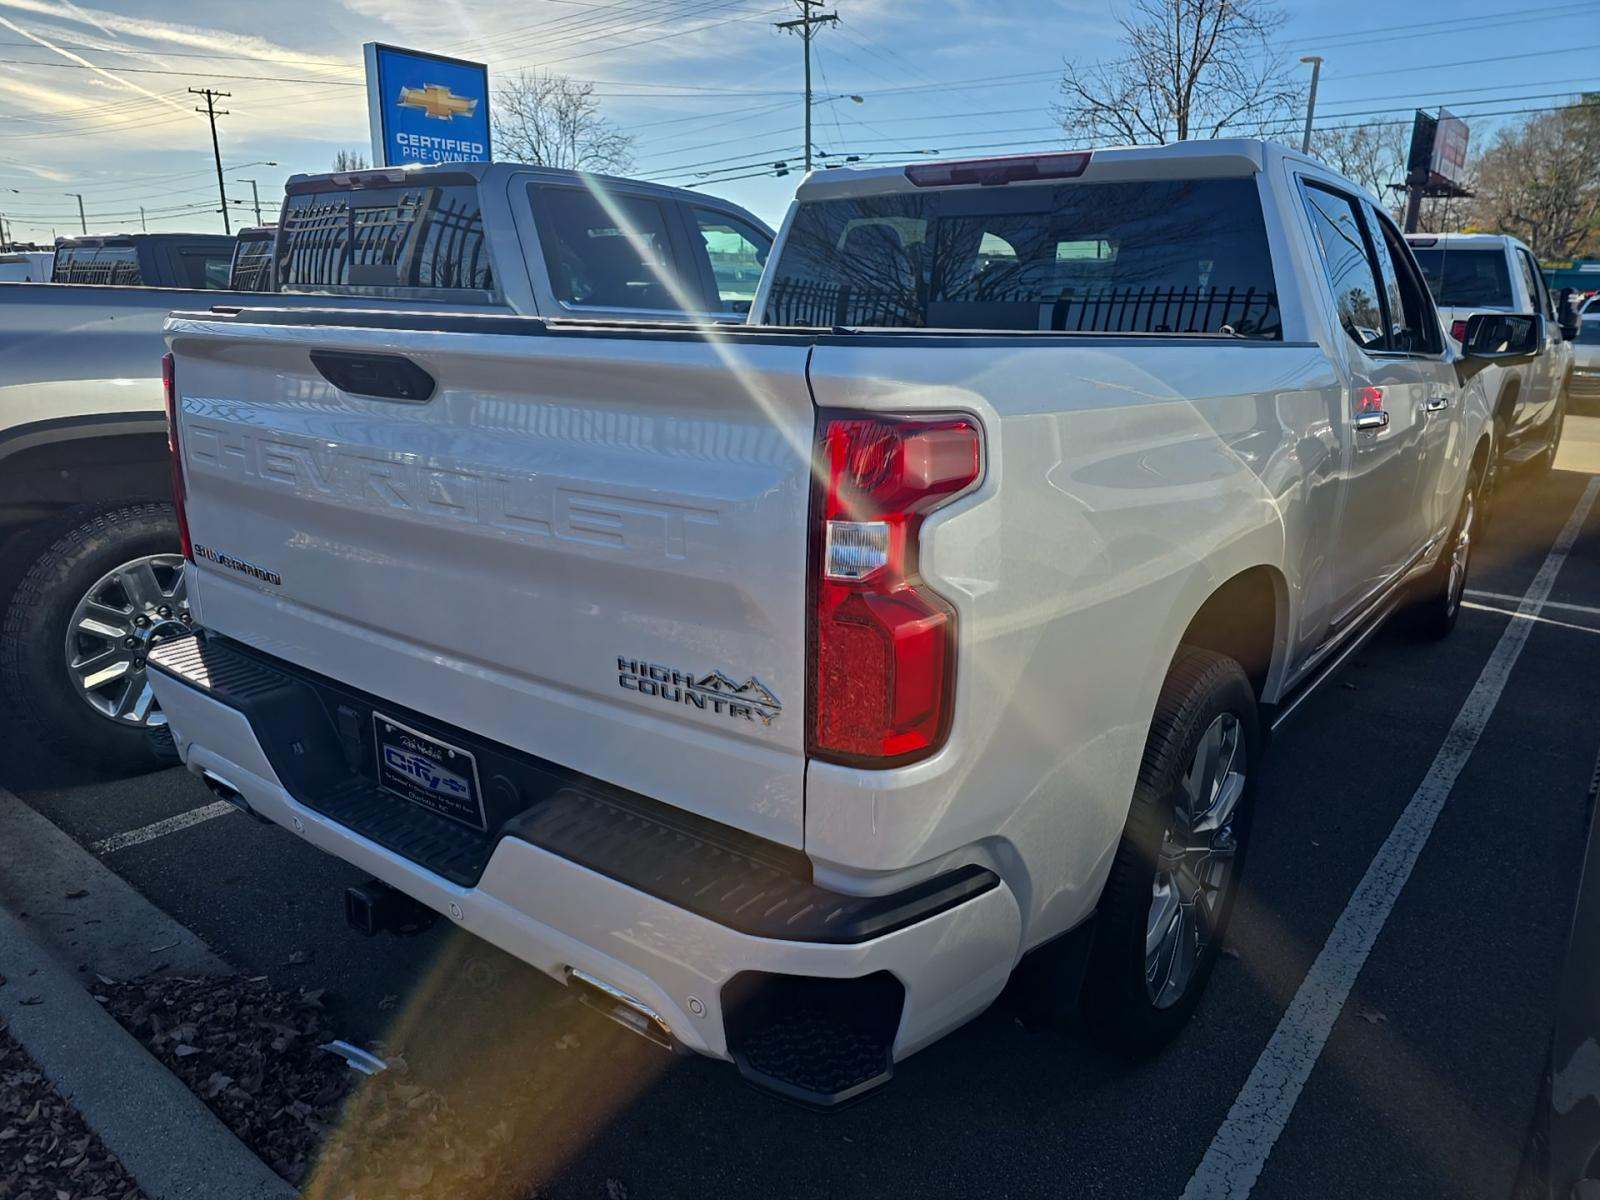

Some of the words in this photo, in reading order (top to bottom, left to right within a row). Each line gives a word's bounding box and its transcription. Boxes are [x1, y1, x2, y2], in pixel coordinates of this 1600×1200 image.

[396, 132, 484, 154] CERTIFIED
[402, 146, 480, 162] PRE-OWNED
[187, 423, 721, 560] CHEVROLET
[616, 655, 695, 689] HIGH
[618, 672, 782, 727] COUNTRY
